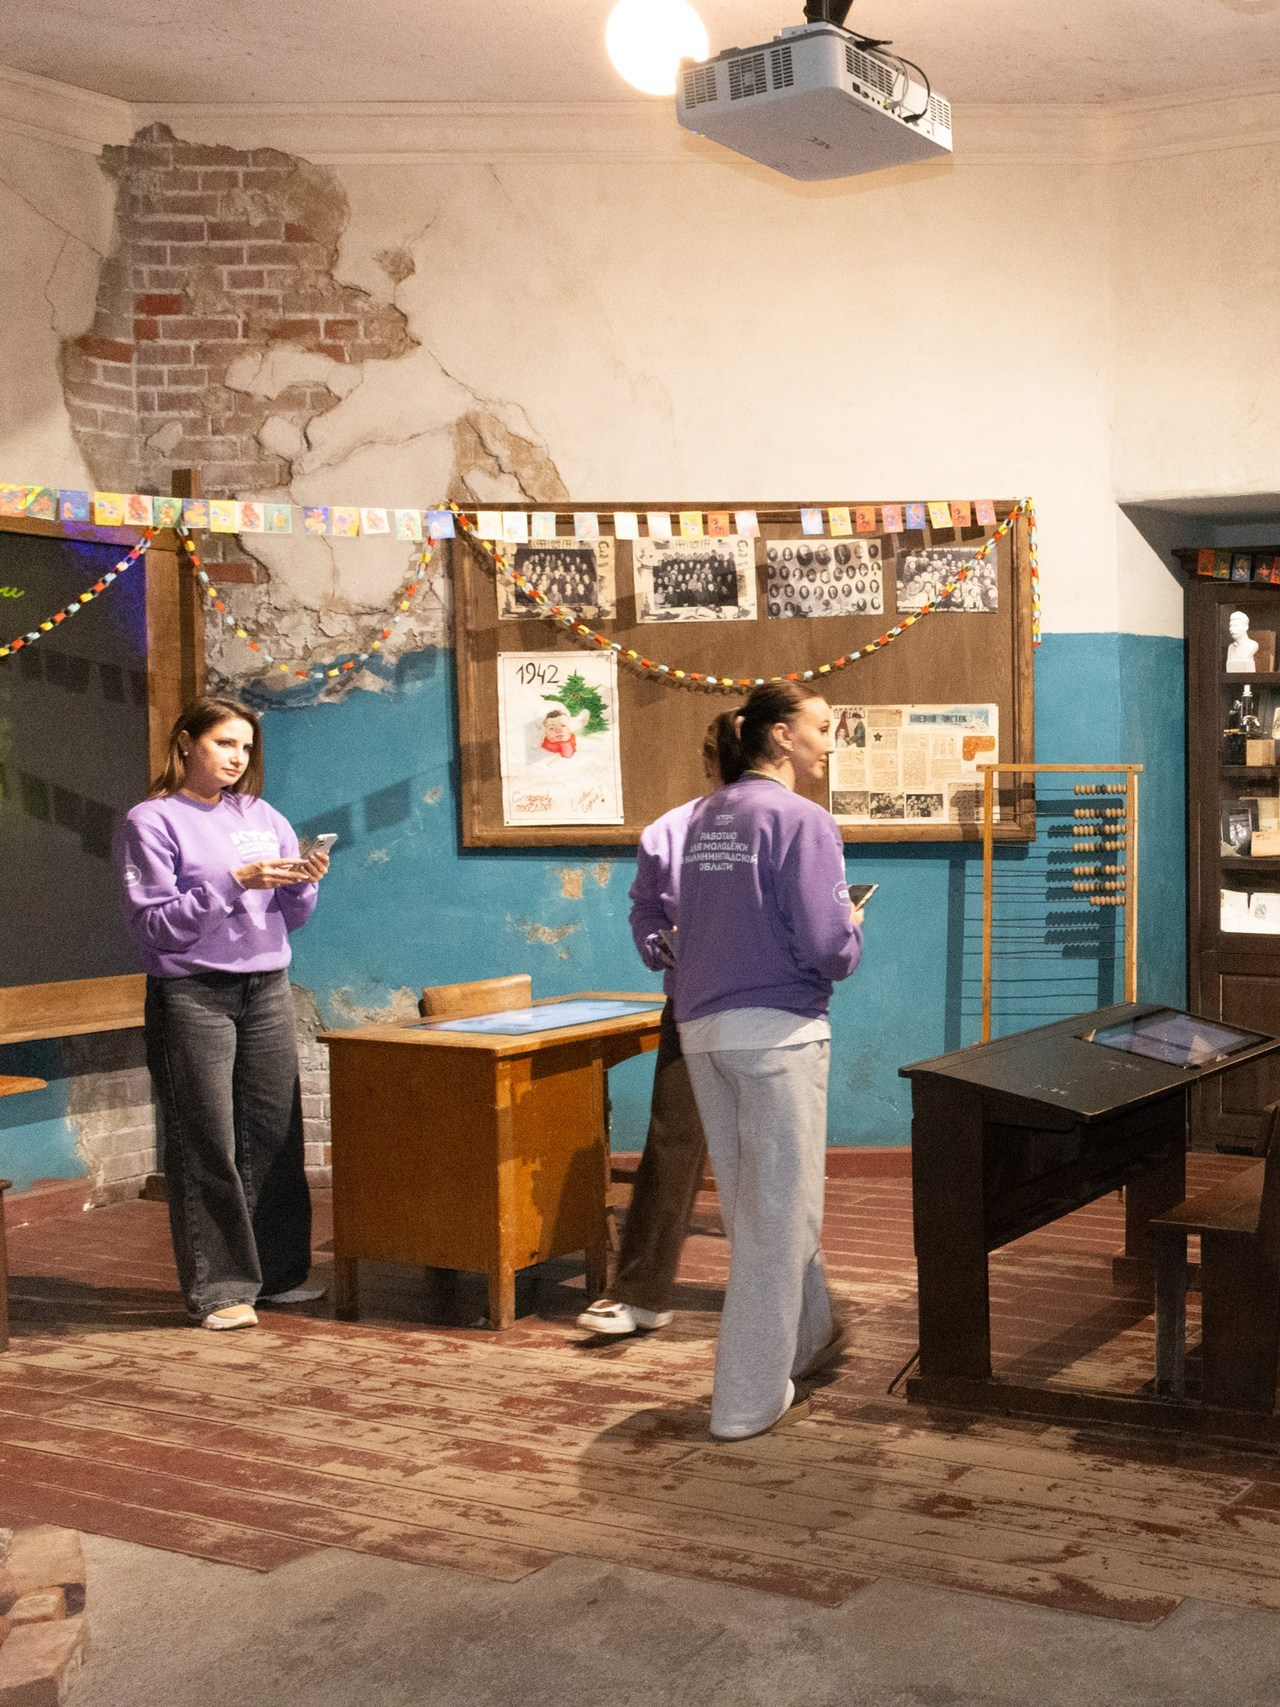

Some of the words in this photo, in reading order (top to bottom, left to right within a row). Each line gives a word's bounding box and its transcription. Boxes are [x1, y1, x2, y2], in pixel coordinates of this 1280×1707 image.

[516, 662, 560, 685] 1942
[909, 714, 937, 723] БОЕВОЙ
[941, 714, 968, 723] ЛИСТОК
[700, 831, 738, 841] РАБОТАЮ
